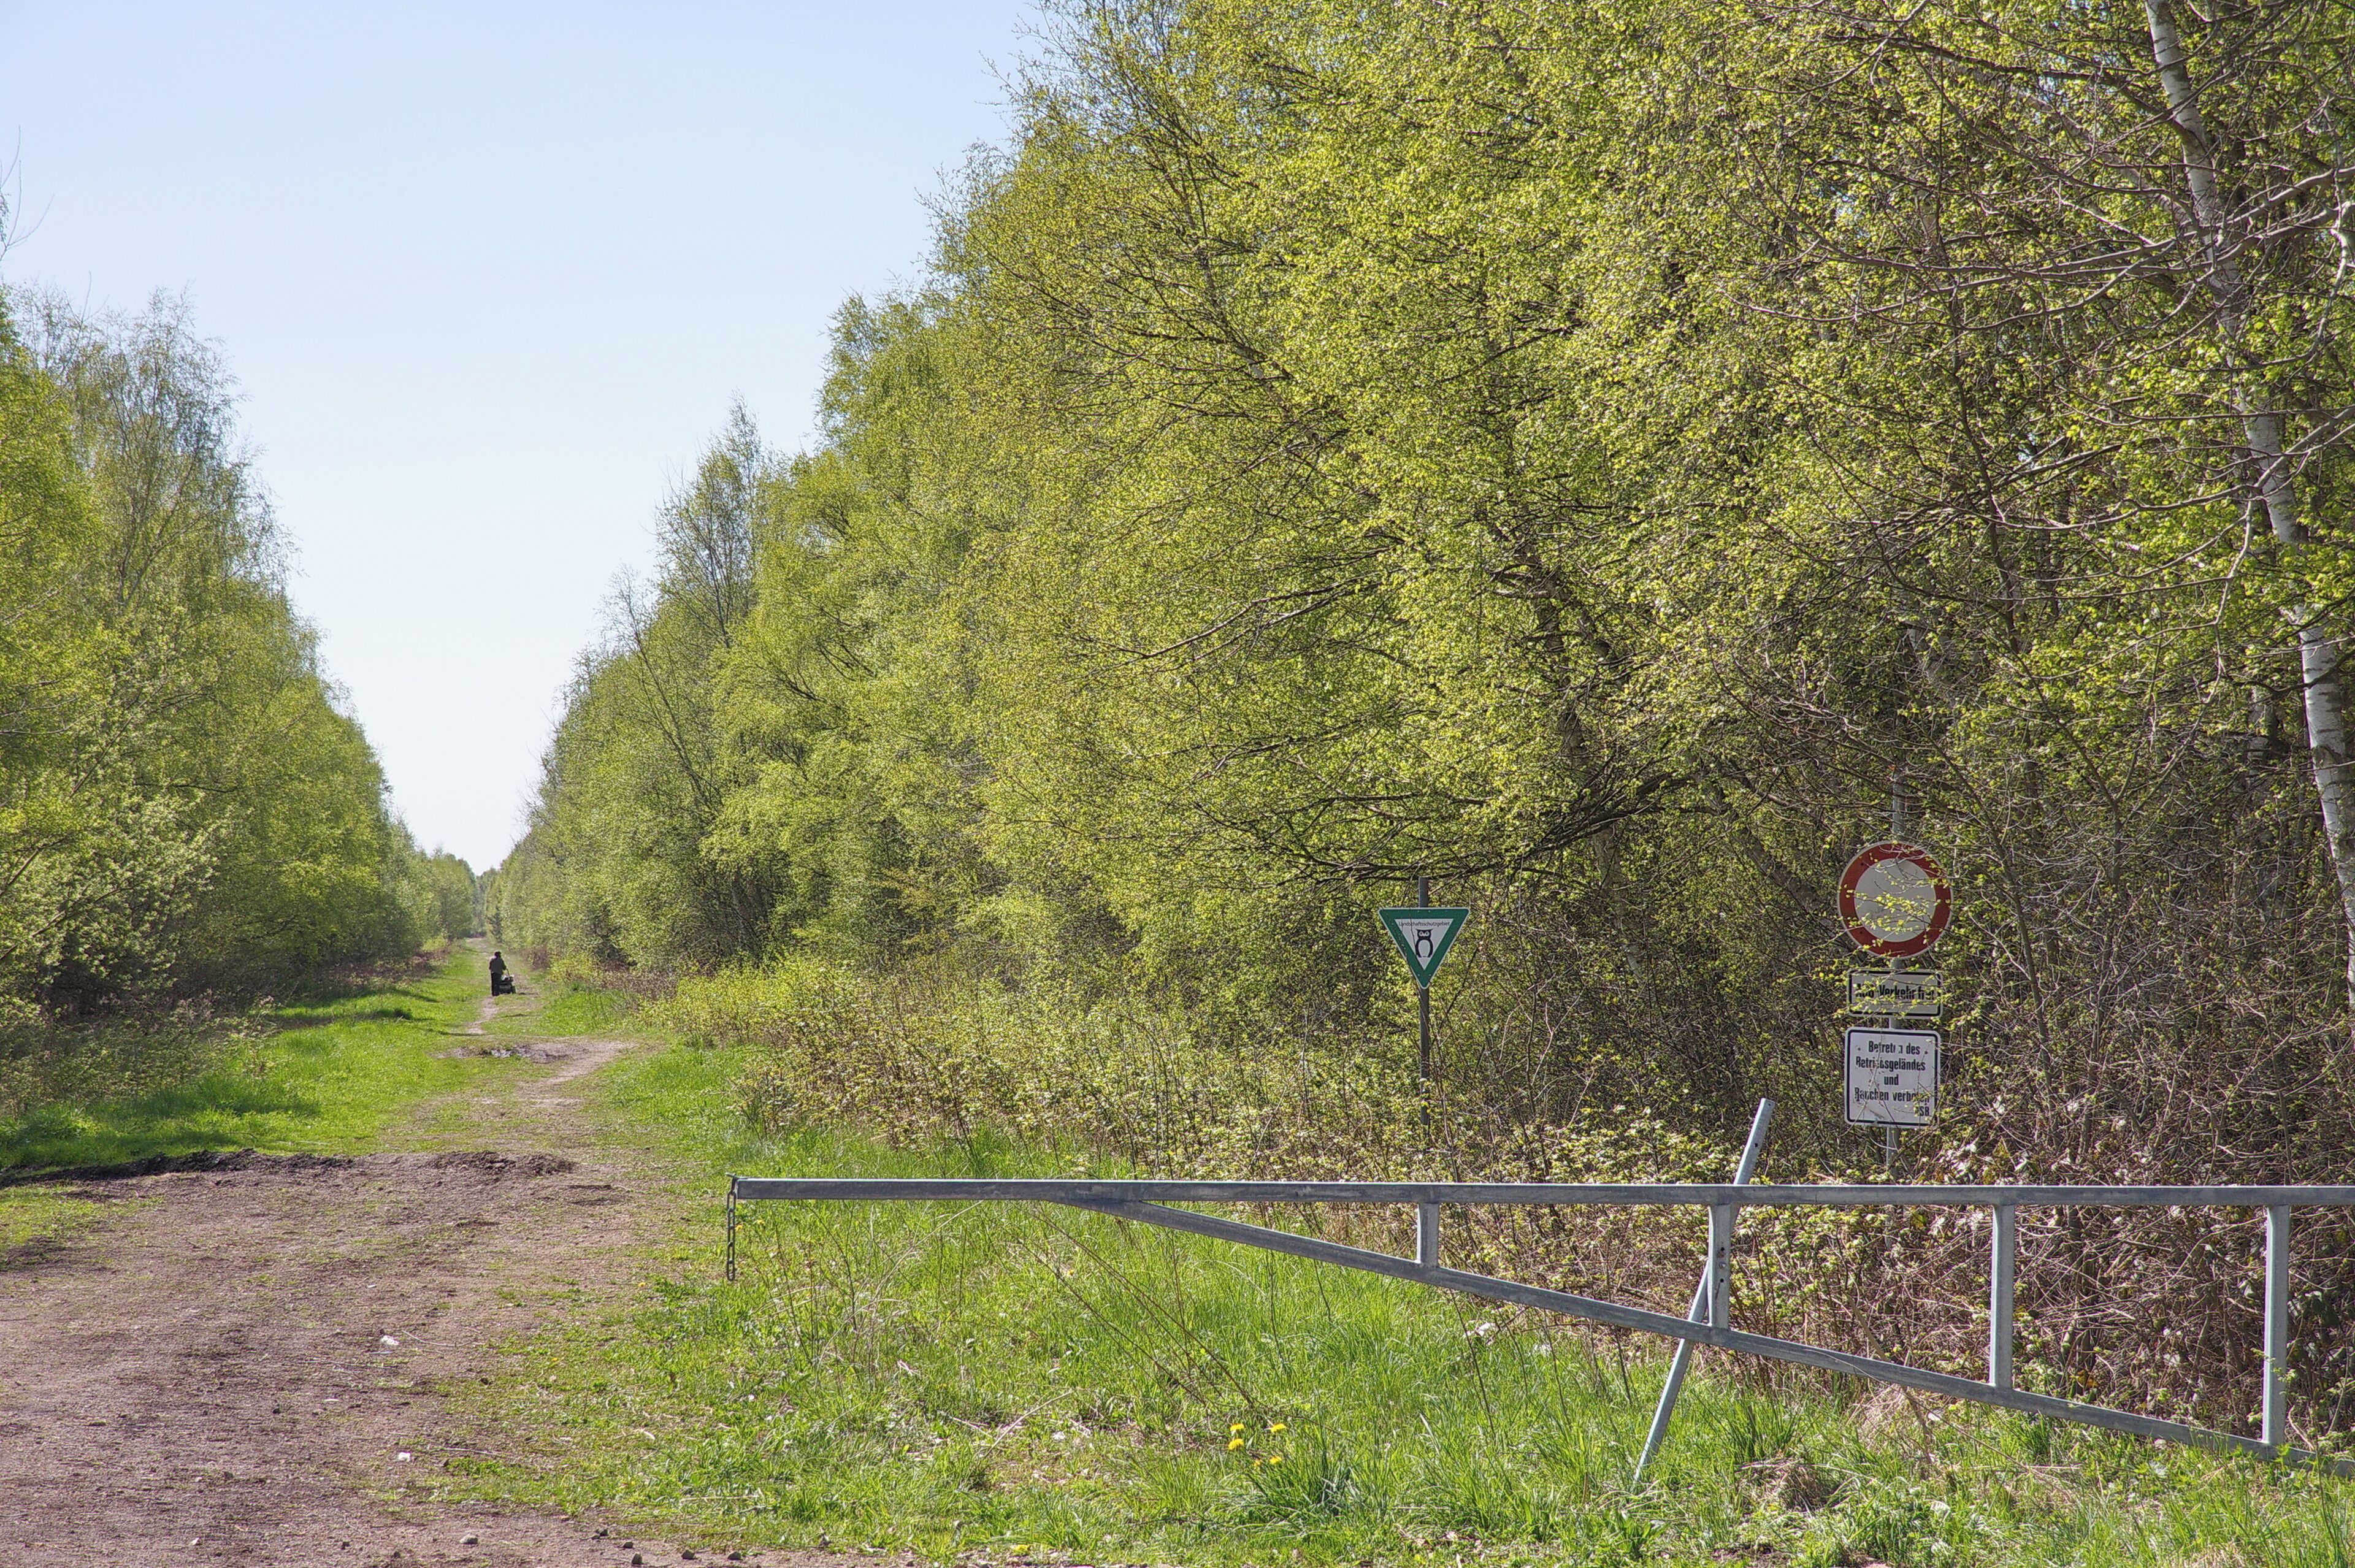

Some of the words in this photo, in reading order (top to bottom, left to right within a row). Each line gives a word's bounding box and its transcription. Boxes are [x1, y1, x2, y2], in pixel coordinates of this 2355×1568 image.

[1905, 1042, 1920, 1055] des
[1883, 1074, 1899, 1085] und
[1854, 1087, 1889, 1101] Rauchen
